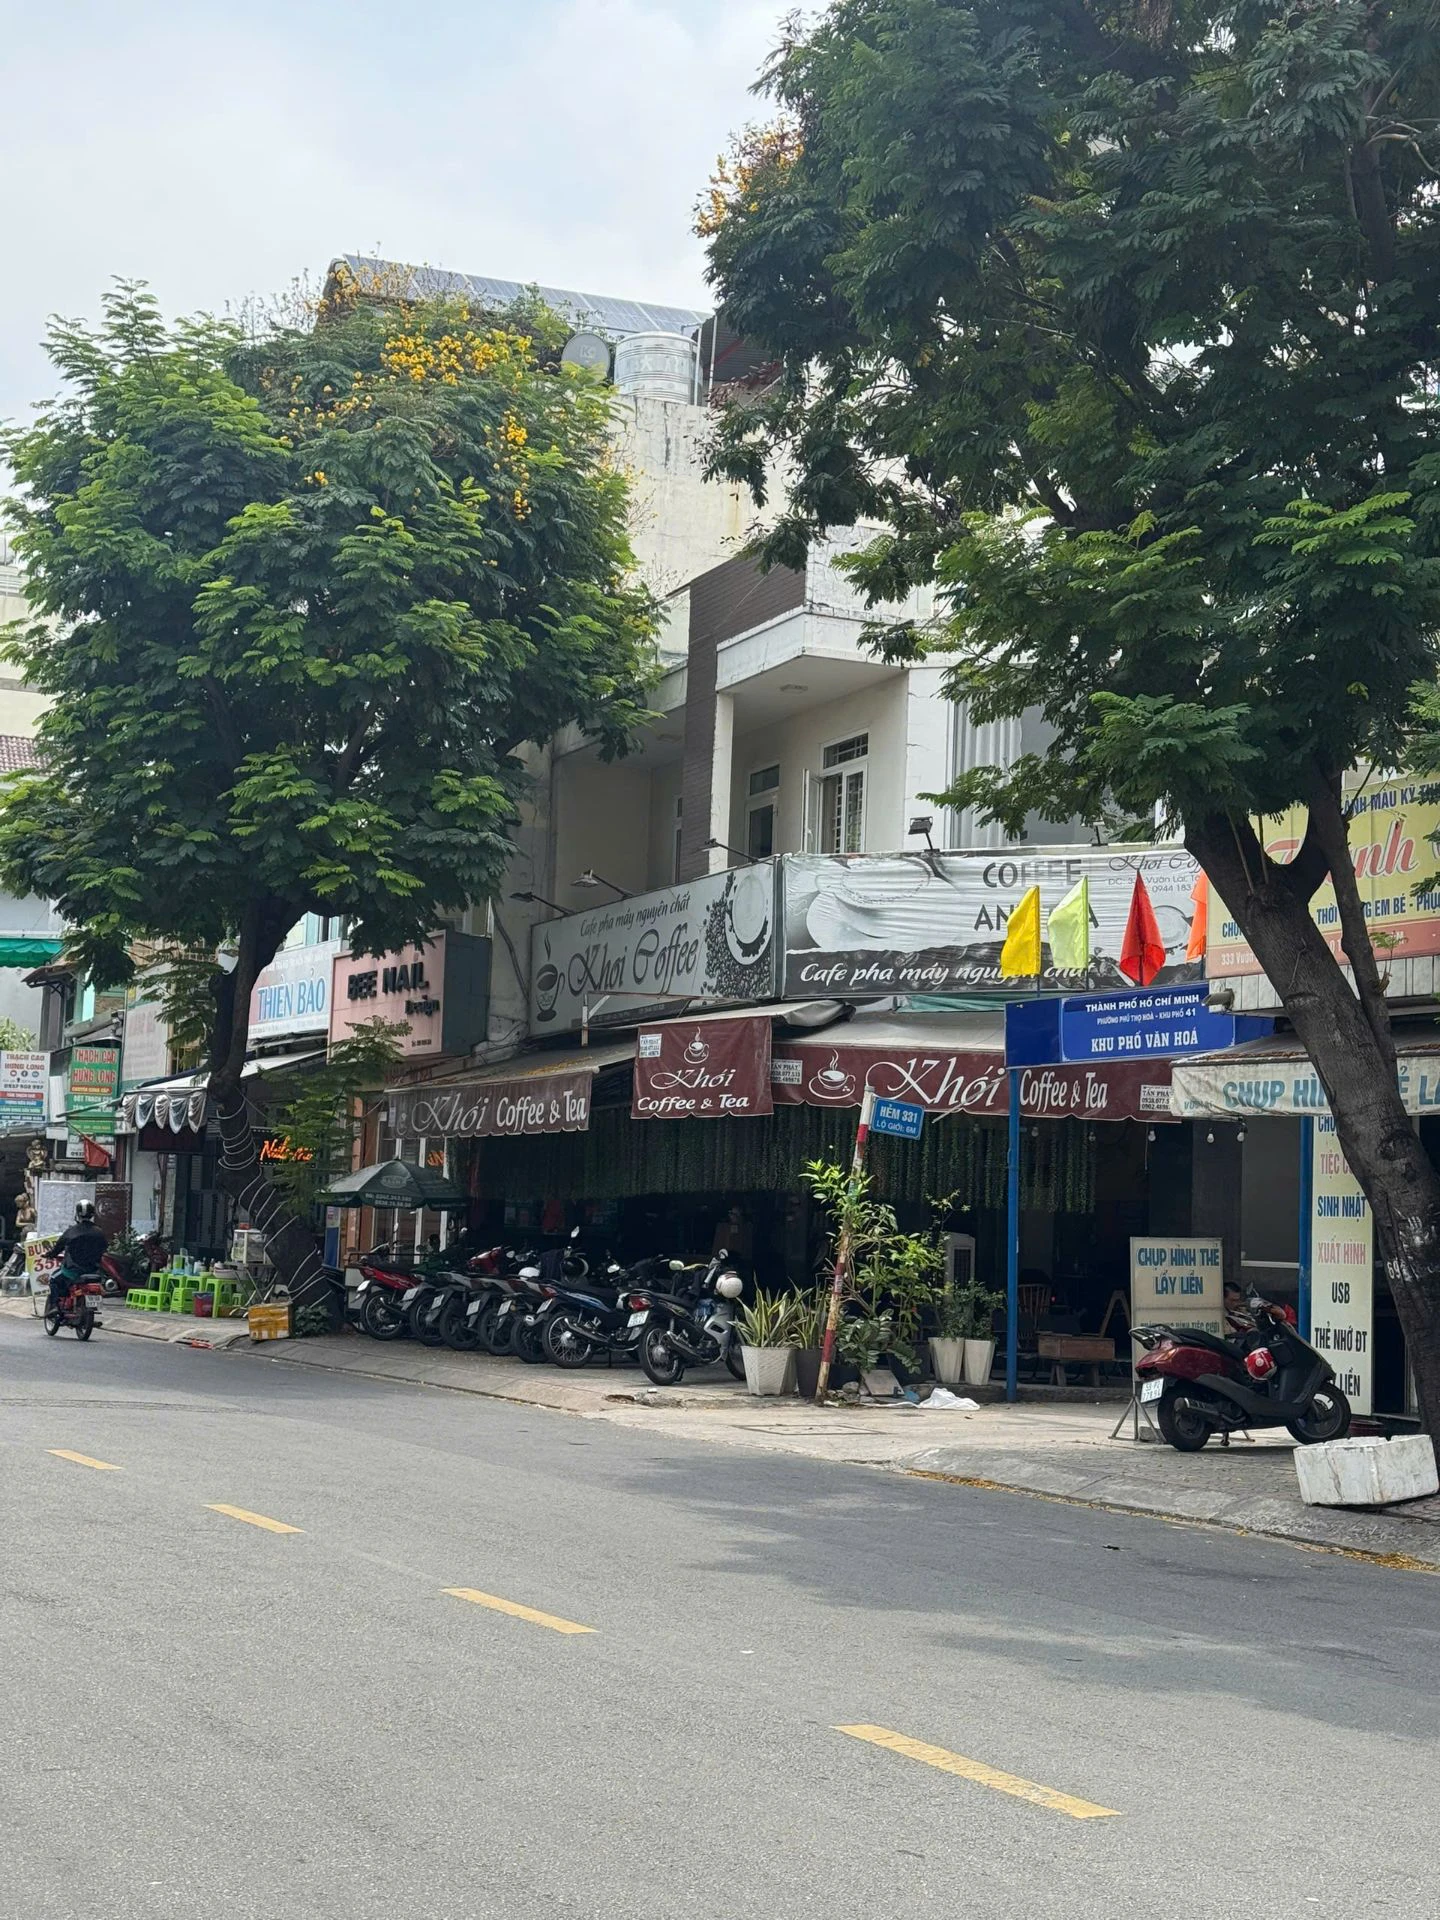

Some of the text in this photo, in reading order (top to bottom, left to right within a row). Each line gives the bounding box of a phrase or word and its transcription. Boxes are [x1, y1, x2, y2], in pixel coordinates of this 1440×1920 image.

[983, 859, 1082, 888] COFFEE
[1152, 885, 1173, 893] 0944
[598, 913, 613, 936] pha
[615, 907, 635, 930] máy
[636, 900, 668, 927] nguyên
[669, 891, 691, 911] chất
[1316, 902, 1338, 925] THỜI
[1375, 901, 1390, 917] EM
[1393, 893, 1407, 914] BÉ
[633, 922, 699, 996] Coffee
[348, 970, 378, 1000] BEE
[800, 962, 848, 986] Cafe
[849, 962, 893, 986] pha
[899, 962, 949, 985] máy
[298, 967, 326, 1014] BẢO
[1085, 1001, 1116, 1013] THÀNH
[1118, 996, 1139, 1009] PHỐ
[1154, 993, 1171, 1006] CHÍ
[1173, 994, 1199, 1004] MINH
[1119, 1010, 1131, 1023] PHÚ
[1159, 1010, 1171, 1020] KHU
[1171, 1007, 1184, 1018] PHỐ
[1185, 1007, 1196, 1018] 41
[1091, 1027, 1198, 1053] KHU PHỐ VĂN HOÁ
[101, 1050, 116, 1063] CAO
[650, 1068, 737, 1090] Khói
[866, 1056, 1108, 1112] Khói Coffee & Tea
[411, 1092, 489, 1132] Khói
[496, 1096, 545, 1131] Coffee
[549, 1100, 561, 1124] &
[563, 1090, 587, 1122] Tea
[637, 1094, 749, 1113] Coffee & Tea
[880, 1104, 918, 1123] HẺM 331
[1318, 1191, 1366, 1222] SINH NHẬT
[1138, 1248, 1167, 1270] CHỤP
[1170, 1244, 1196, 1266] HÌNH
[1318, 1235, 1341, 1264] XUẤT
[1155, 1269, 1177, 1295] LẤY
[1332, 1282, 1350, 1304] USB
[1314, 1321, 1367, 1352] THẺ NHỚ ĐT
